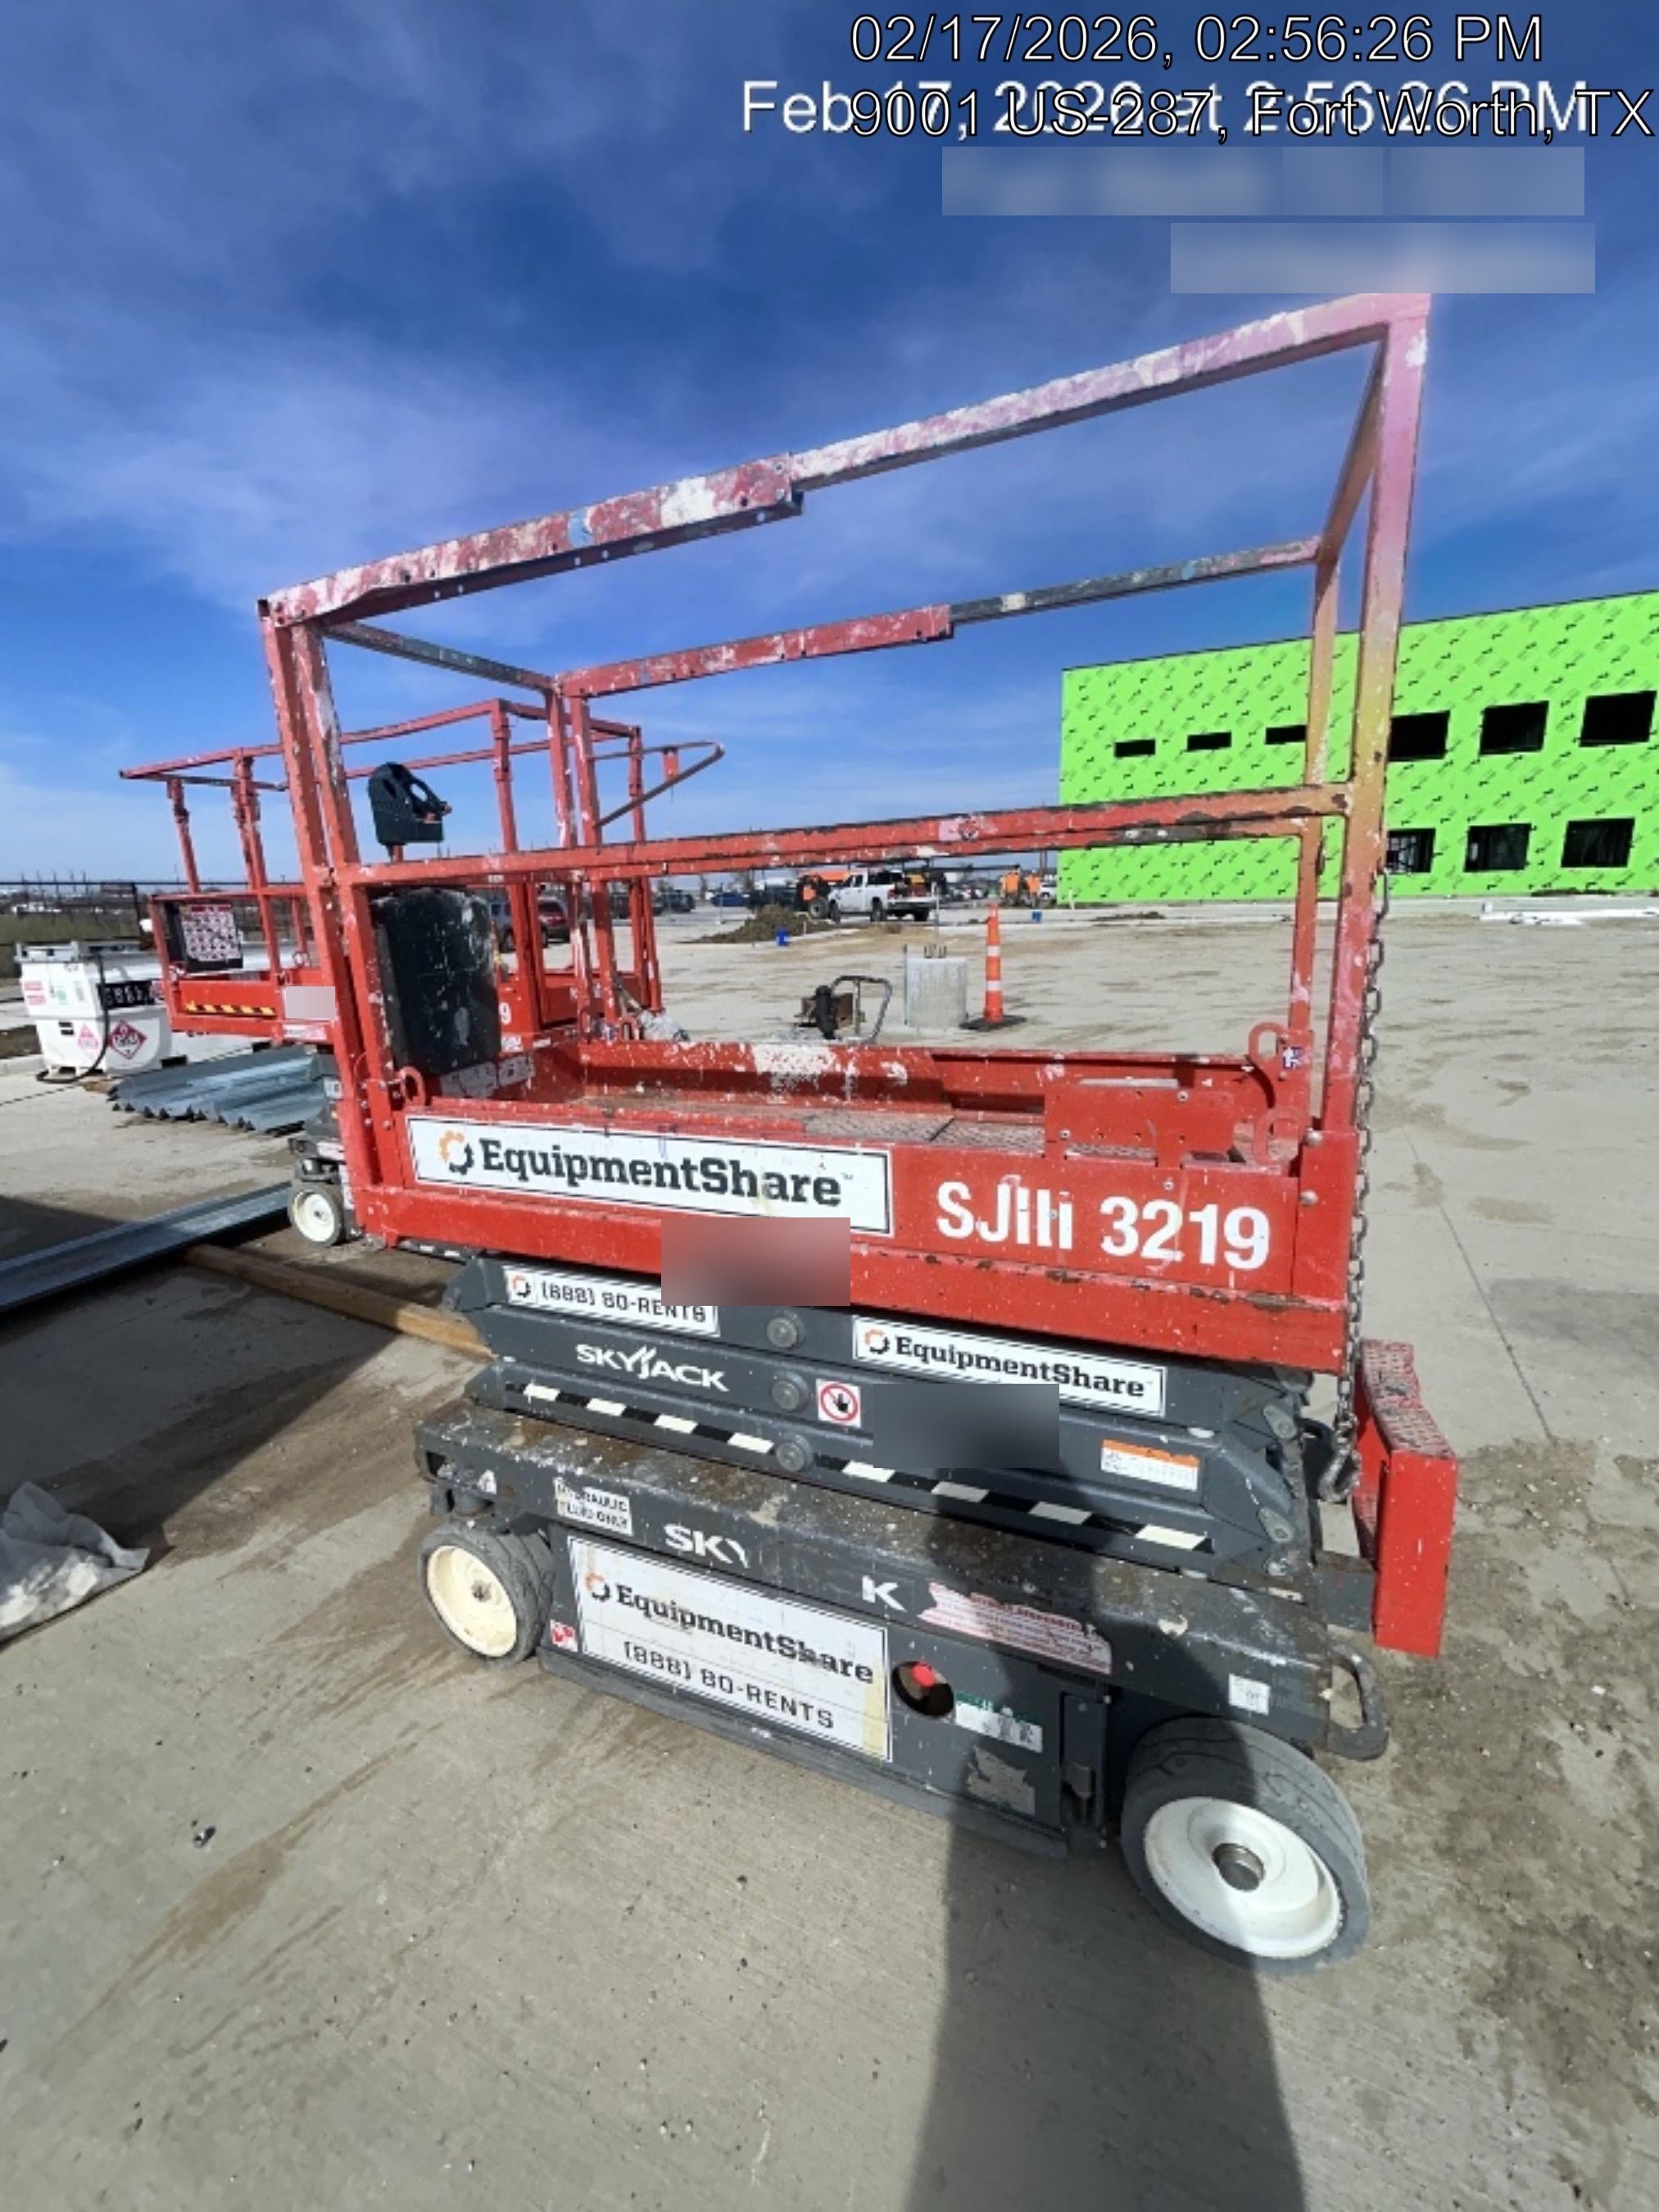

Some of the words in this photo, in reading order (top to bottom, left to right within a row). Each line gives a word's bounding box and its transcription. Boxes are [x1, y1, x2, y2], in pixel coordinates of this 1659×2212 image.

[478, 1137, 842, 1208] EquipmentShare
[1099, 1196, 1271, 1271] 3219
[575, 1344, 730, 1392] SKYJACK
[895, 1335, 1145, 1398] EquipmentShare
[614, 1584, 873, 1684] EquipmentShare
[624, 1640, 691, 1680] (888)
[700, 1668, 834, 1729] 80-RENTS
